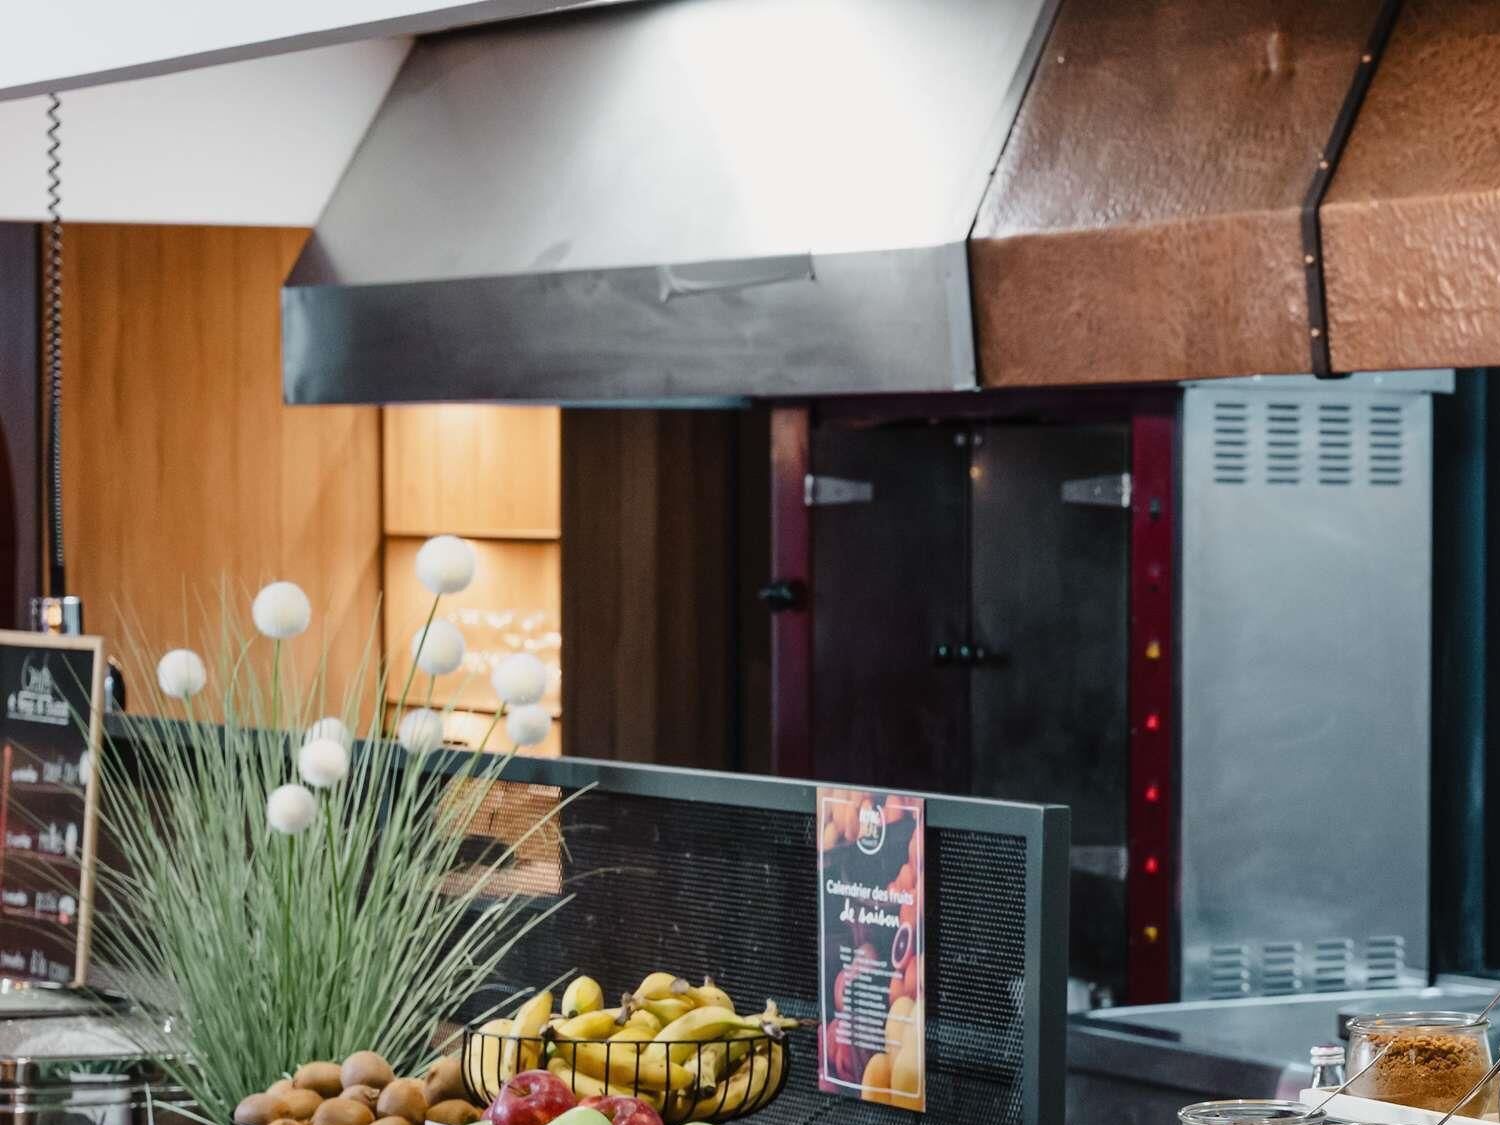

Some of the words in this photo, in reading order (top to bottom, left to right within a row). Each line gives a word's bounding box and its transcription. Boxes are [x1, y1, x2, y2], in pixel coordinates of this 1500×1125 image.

[826, 879, 871, 899] Calendrier
[872, 886, 889, 902] des
[840, 898, 855, 923] de
[858, 903, 899, 927] saison
